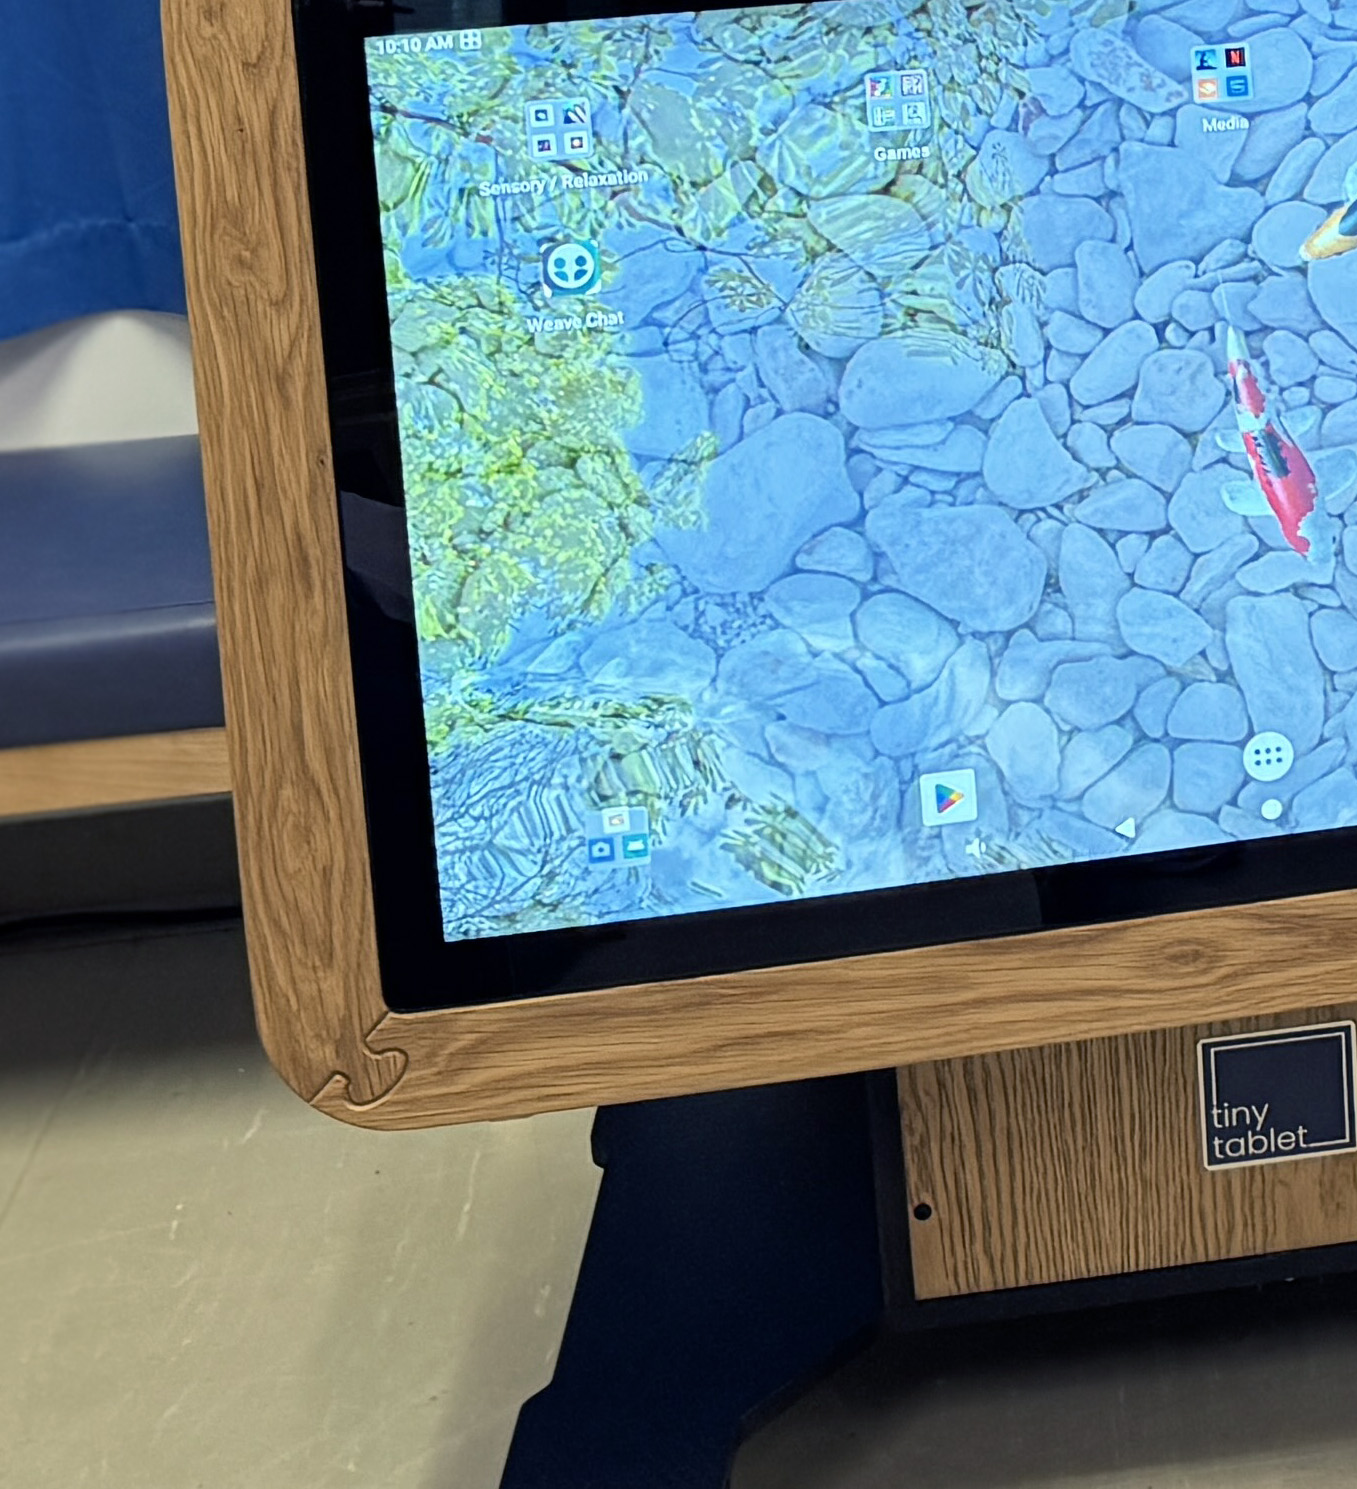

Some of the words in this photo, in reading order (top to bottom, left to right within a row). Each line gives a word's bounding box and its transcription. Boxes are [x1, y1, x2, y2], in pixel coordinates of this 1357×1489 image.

[375, 38, 421, 55] 10:10
[425, 35, 454, 51] AM
[1202, 116, 1250, 133] Media
[874, 145, 930, 161] Games
[479, 179, 546, 197] Sensory
[561, 169, 649, 190] Relaxation
[526, 317, 582, 333] Weave
[586, 311, 624, 328] Chat
[1211, 1102, 1269, 1131] tiny
[1213, 1125, 1308, 1159] tablet
